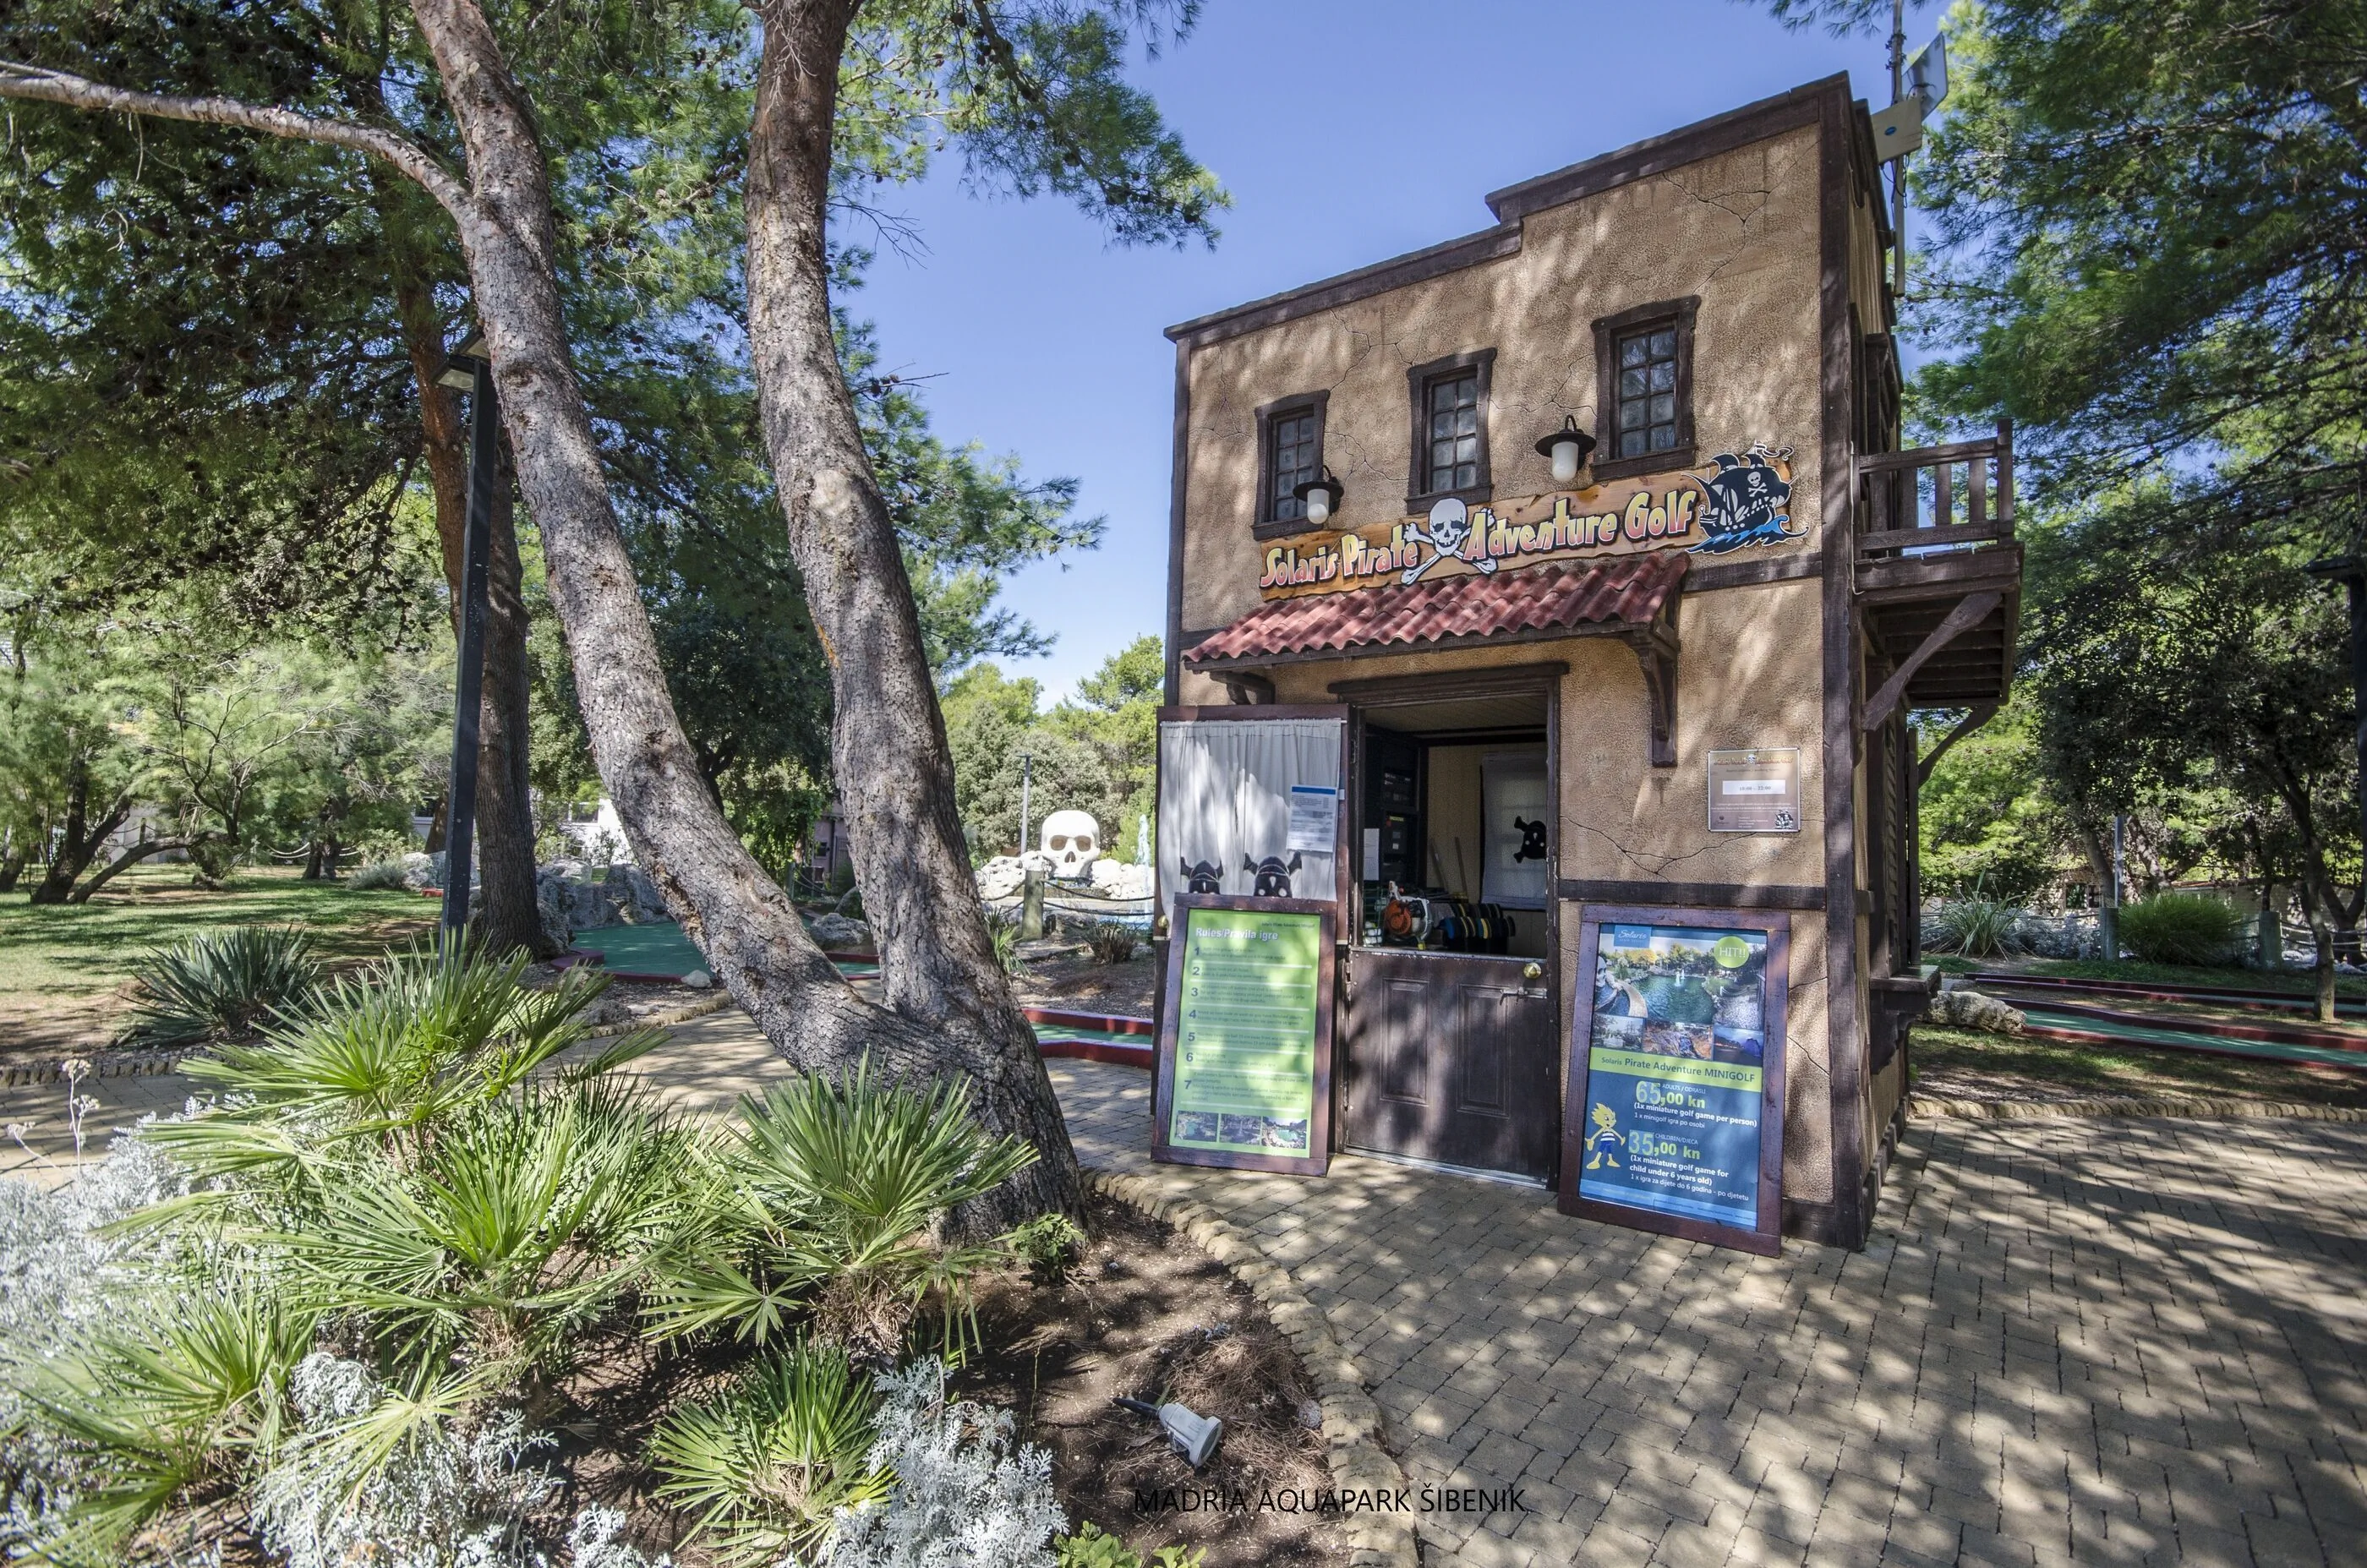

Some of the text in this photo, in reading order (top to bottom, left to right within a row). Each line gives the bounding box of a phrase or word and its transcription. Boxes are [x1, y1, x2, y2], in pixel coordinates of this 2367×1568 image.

[1260, 489, 1697, 588] Solaris Pirate Adventure Golf
[1195, 927, 1278, 942] Rules/Pravila igre
[1618, 930, 1648, 939] Solaris
[1194, 947, 1200, 956] 1
[1719, 947, 1746, 958] HIT!!
[1192, 966, 1200, 975] 2
[1191, 987, 1199, 997] 3
[1189, 1009, 1196, 1019] 4
[1188, 1032, 1195, 1041] 5
[1186, 1052, 1194, 1063] 6
[1601, 1057, 1755, 1083] Solaris Pirate Adventure MINIGOLF
[1184, 1079, 1192, 1090] 7
[1662, 1083, 1681, 1091] ADULTS
[1685, 1086, 1706, 1095] ODRASLI
[1636, 1080, 1705, 1109] 65,00 kn
[1643, 1113, 1666, 1123] minigolf
[1689, 1120, 1705, 1128] osobi
[1646, 1104, 1678, 1115] miniature
[1680, 1108, 1694, 1117] golf
[1695, 1112, 1714, 1121] game
[1716, 1115, 1729, 1123] per
[1730, 1117, 1757, 1128] person)
[1629, 1130, 1701, 1160] 35,00 kn
[1643, 1156, 1677, 1169] miniature
[1678, 1161, 1693, 1172] golf
[1694, 1166, 1715, 1176] game
[1717, 1168, 1730, 1177] for
[1629, 1164, 1647, 1173] child
[1648, 1167, 1669, 1177] under
[1676, 1174, 1696, 1183] years
[1697, 1177, 1713, 1187] old)
[1639, 1175, 1651, 1183] igra
[1659, 1179, 1676, 1188] dijete
[1691, 1185, 1713, 1194] godina
[1727, 1192, 1749, 1201] djetetu
